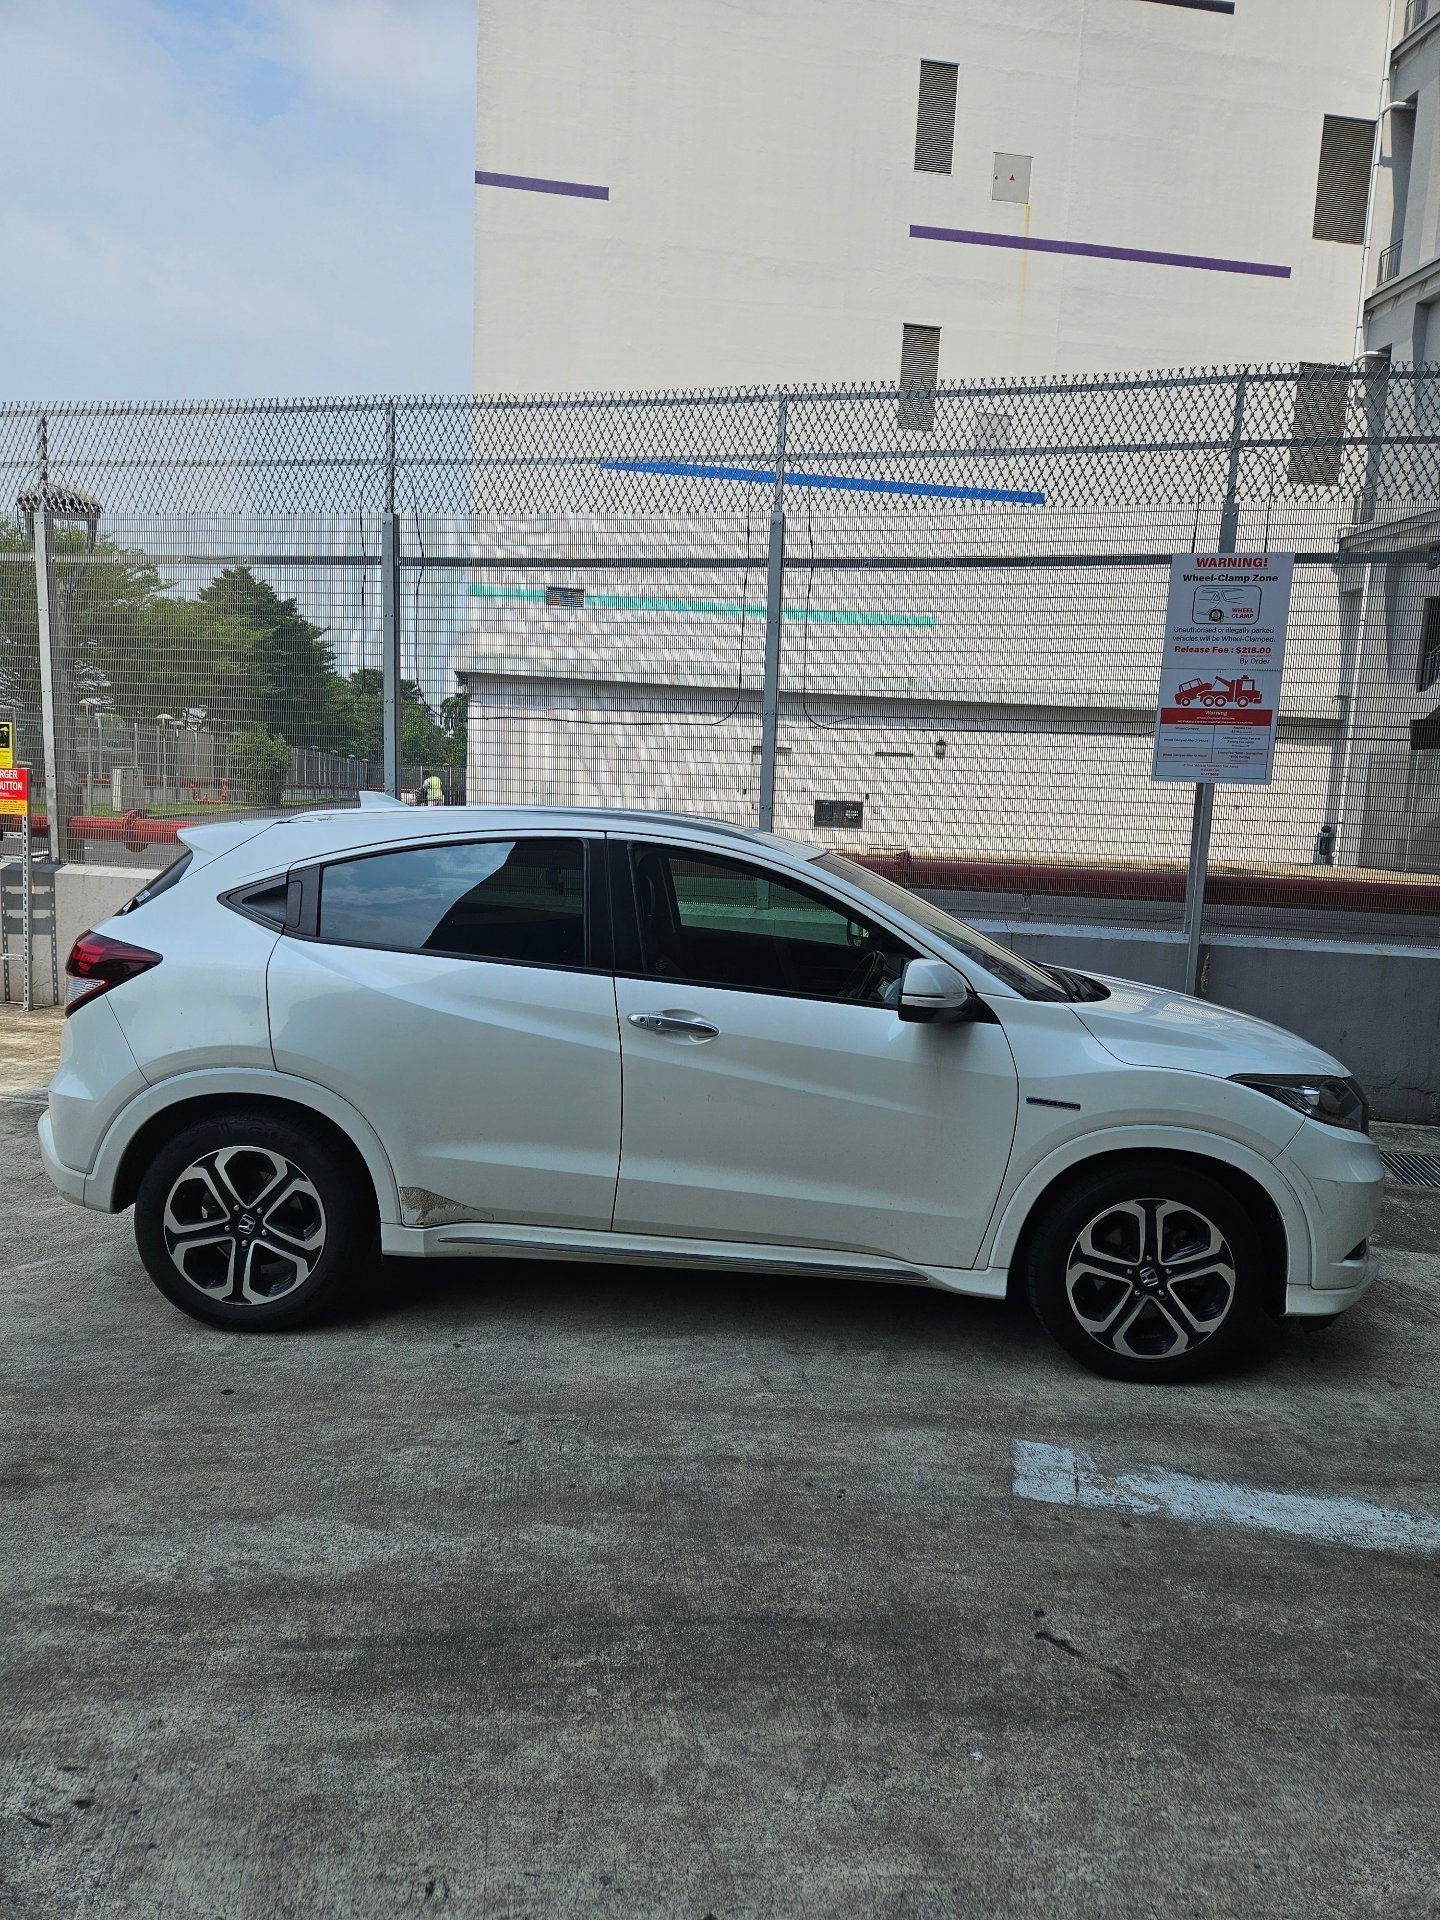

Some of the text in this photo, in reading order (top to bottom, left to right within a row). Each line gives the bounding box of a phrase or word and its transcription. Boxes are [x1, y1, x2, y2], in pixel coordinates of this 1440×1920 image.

[1196, 557, 1268, 568] WARNING!
[1183, 574, 1278, 583] Wheel-Clamp Zone
[1226, 627, 1250, 635] illegally
[1251, 627, 1274, 635] parked
[1174, 646, 1210, 654] Release
[1212, 646, 1229, 654] Fee
[1235, 647, 1272, 655] $218.00
